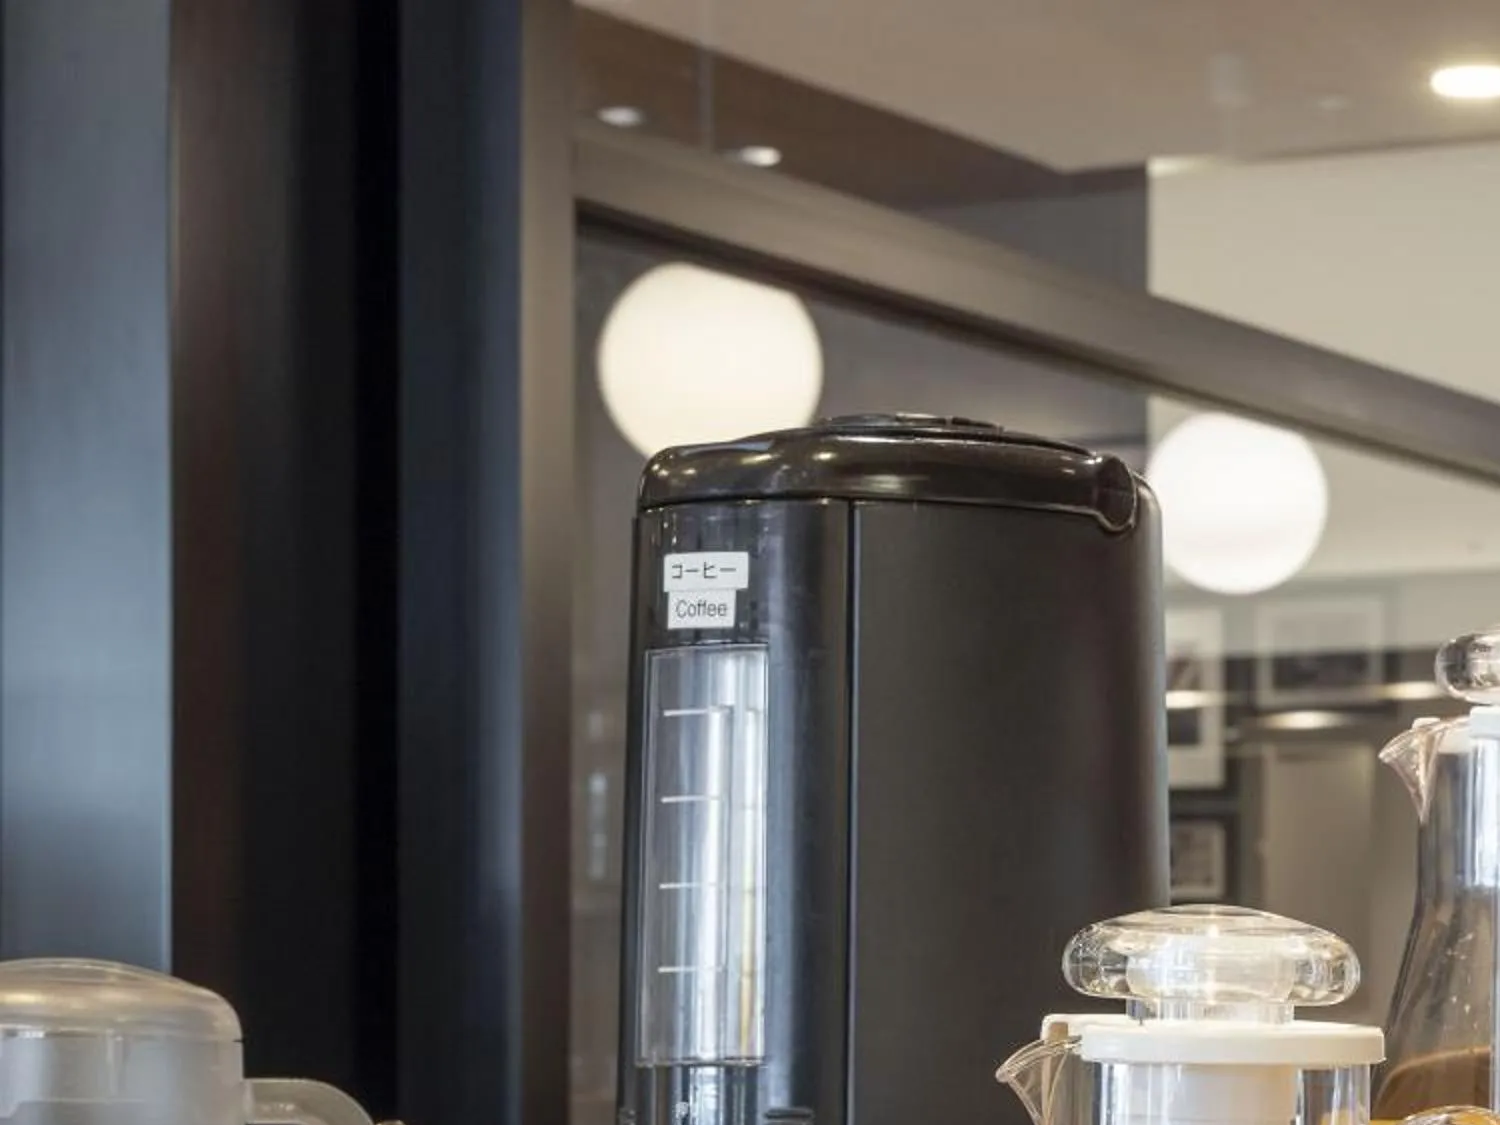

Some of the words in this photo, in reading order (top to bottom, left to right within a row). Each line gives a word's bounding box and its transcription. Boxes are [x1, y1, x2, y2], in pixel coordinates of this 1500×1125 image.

[671, 561, 737, 580] コーヒー
[675, 599, 729, 618] Coffee
